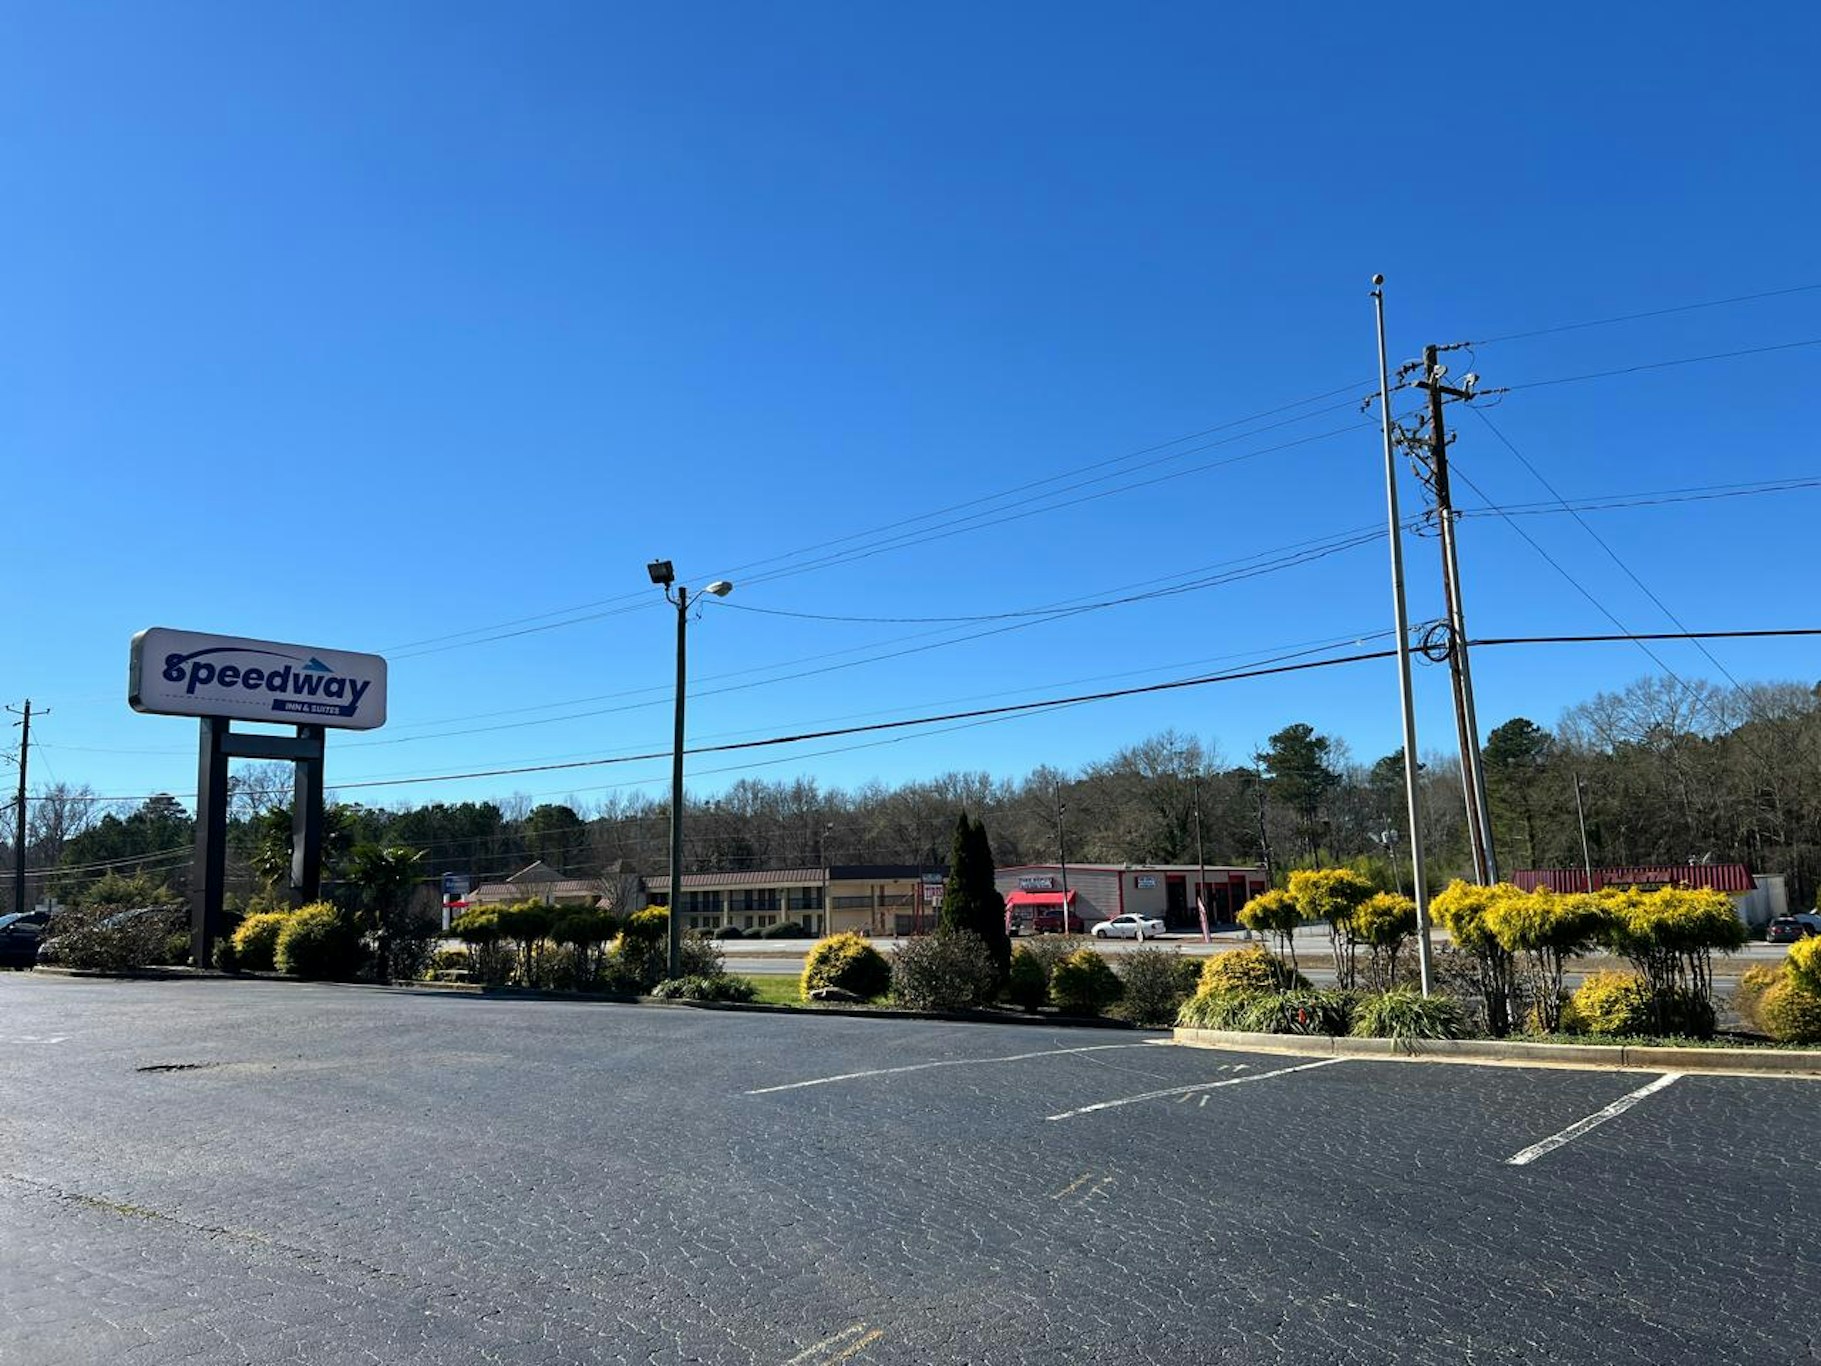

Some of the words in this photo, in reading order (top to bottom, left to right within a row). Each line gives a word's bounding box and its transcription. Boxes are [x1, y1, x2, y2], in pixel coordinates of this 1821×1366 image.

[163, 652, 370, 707] Speedway
[285, 702, 301, 711] INN
[302, 703, 310, 712] &
[311, 704, 340, 715] SUITES
